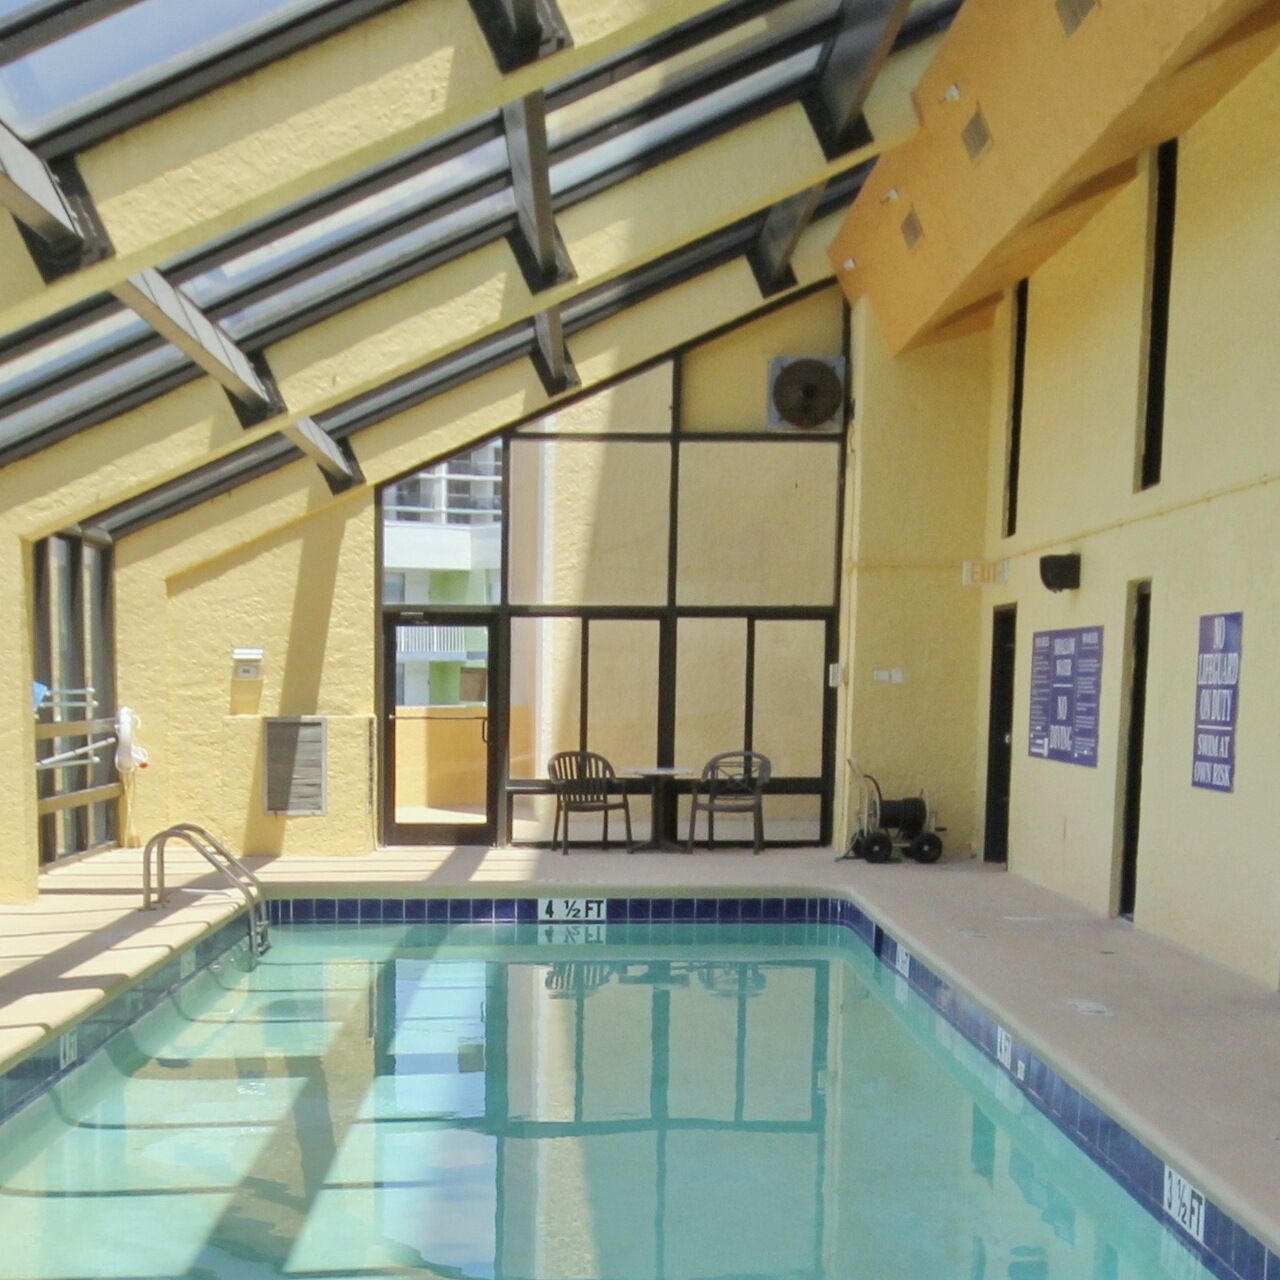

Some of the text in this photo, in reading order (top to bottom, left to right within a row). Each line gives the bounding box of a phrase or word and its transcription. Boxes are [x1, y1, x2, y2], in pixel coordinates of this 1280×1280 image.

[1213, 617, 1226, 649] NO
[1198, 653, 1239, 685] LIFEGUARD
[1200, 689, 1233, 721] ON DUTY
[1197, 734, 1230, 758] SWIM AT
[1194, 762, 1231, 786] OWN RISK
[545, 900, 554, 918] 4
[585, 900, 604, 918] FT
[1189, 1189, 1203, 1236] FT
